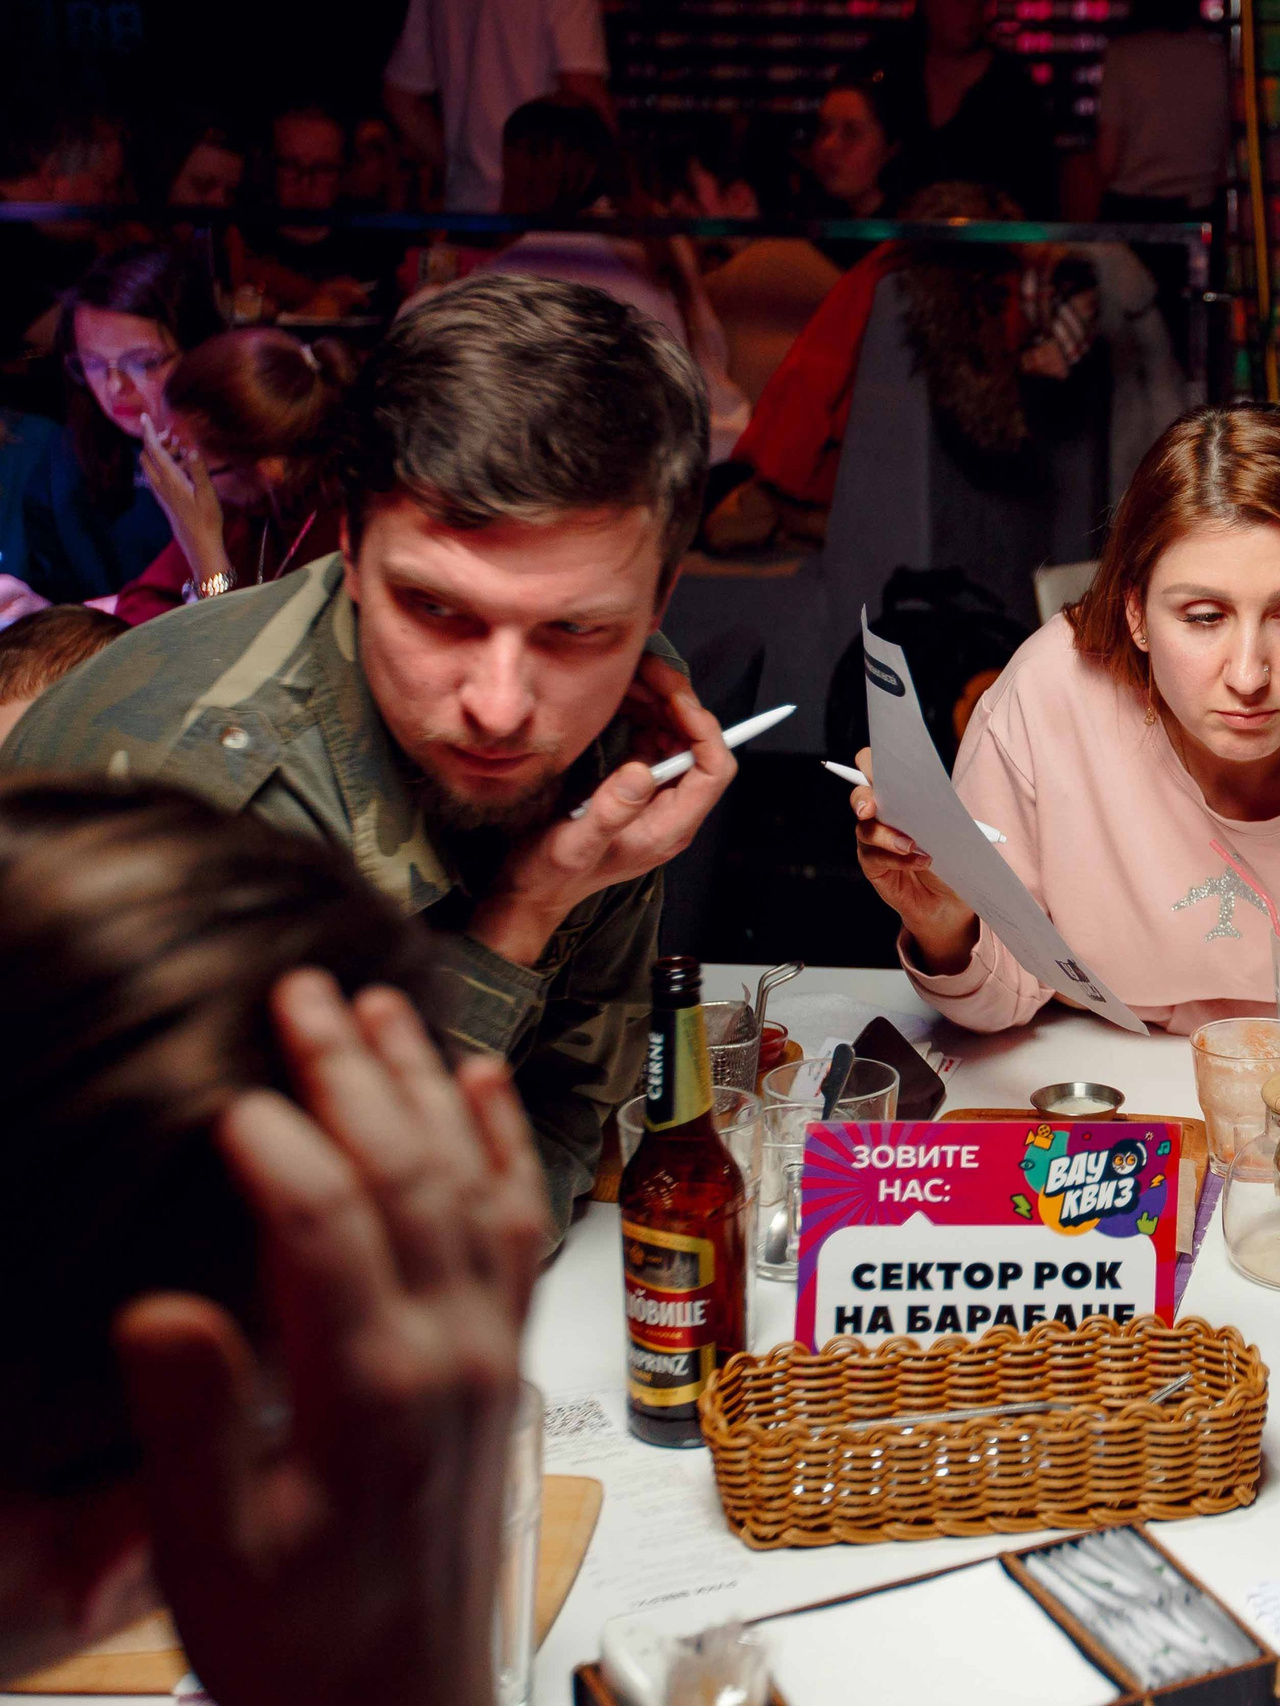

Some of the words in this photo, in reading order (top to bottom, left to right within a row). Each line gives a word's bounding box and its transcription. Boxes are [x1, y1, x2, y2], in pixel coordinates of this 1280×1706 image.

[851, 1145, 980, 1169] ЗОВИТЕ
[1045, 1150, 1109, 1197] ВАУ
[878, 1178, 951, 1203] НАС:
[1062, 1177, 1134, 1220] КВИЗ
[852, 1261, 1023, 1291] СЕКТОР
[1034, 1261, 1123, 1290] РОК
[835, 1305, 894, 1335] НА
